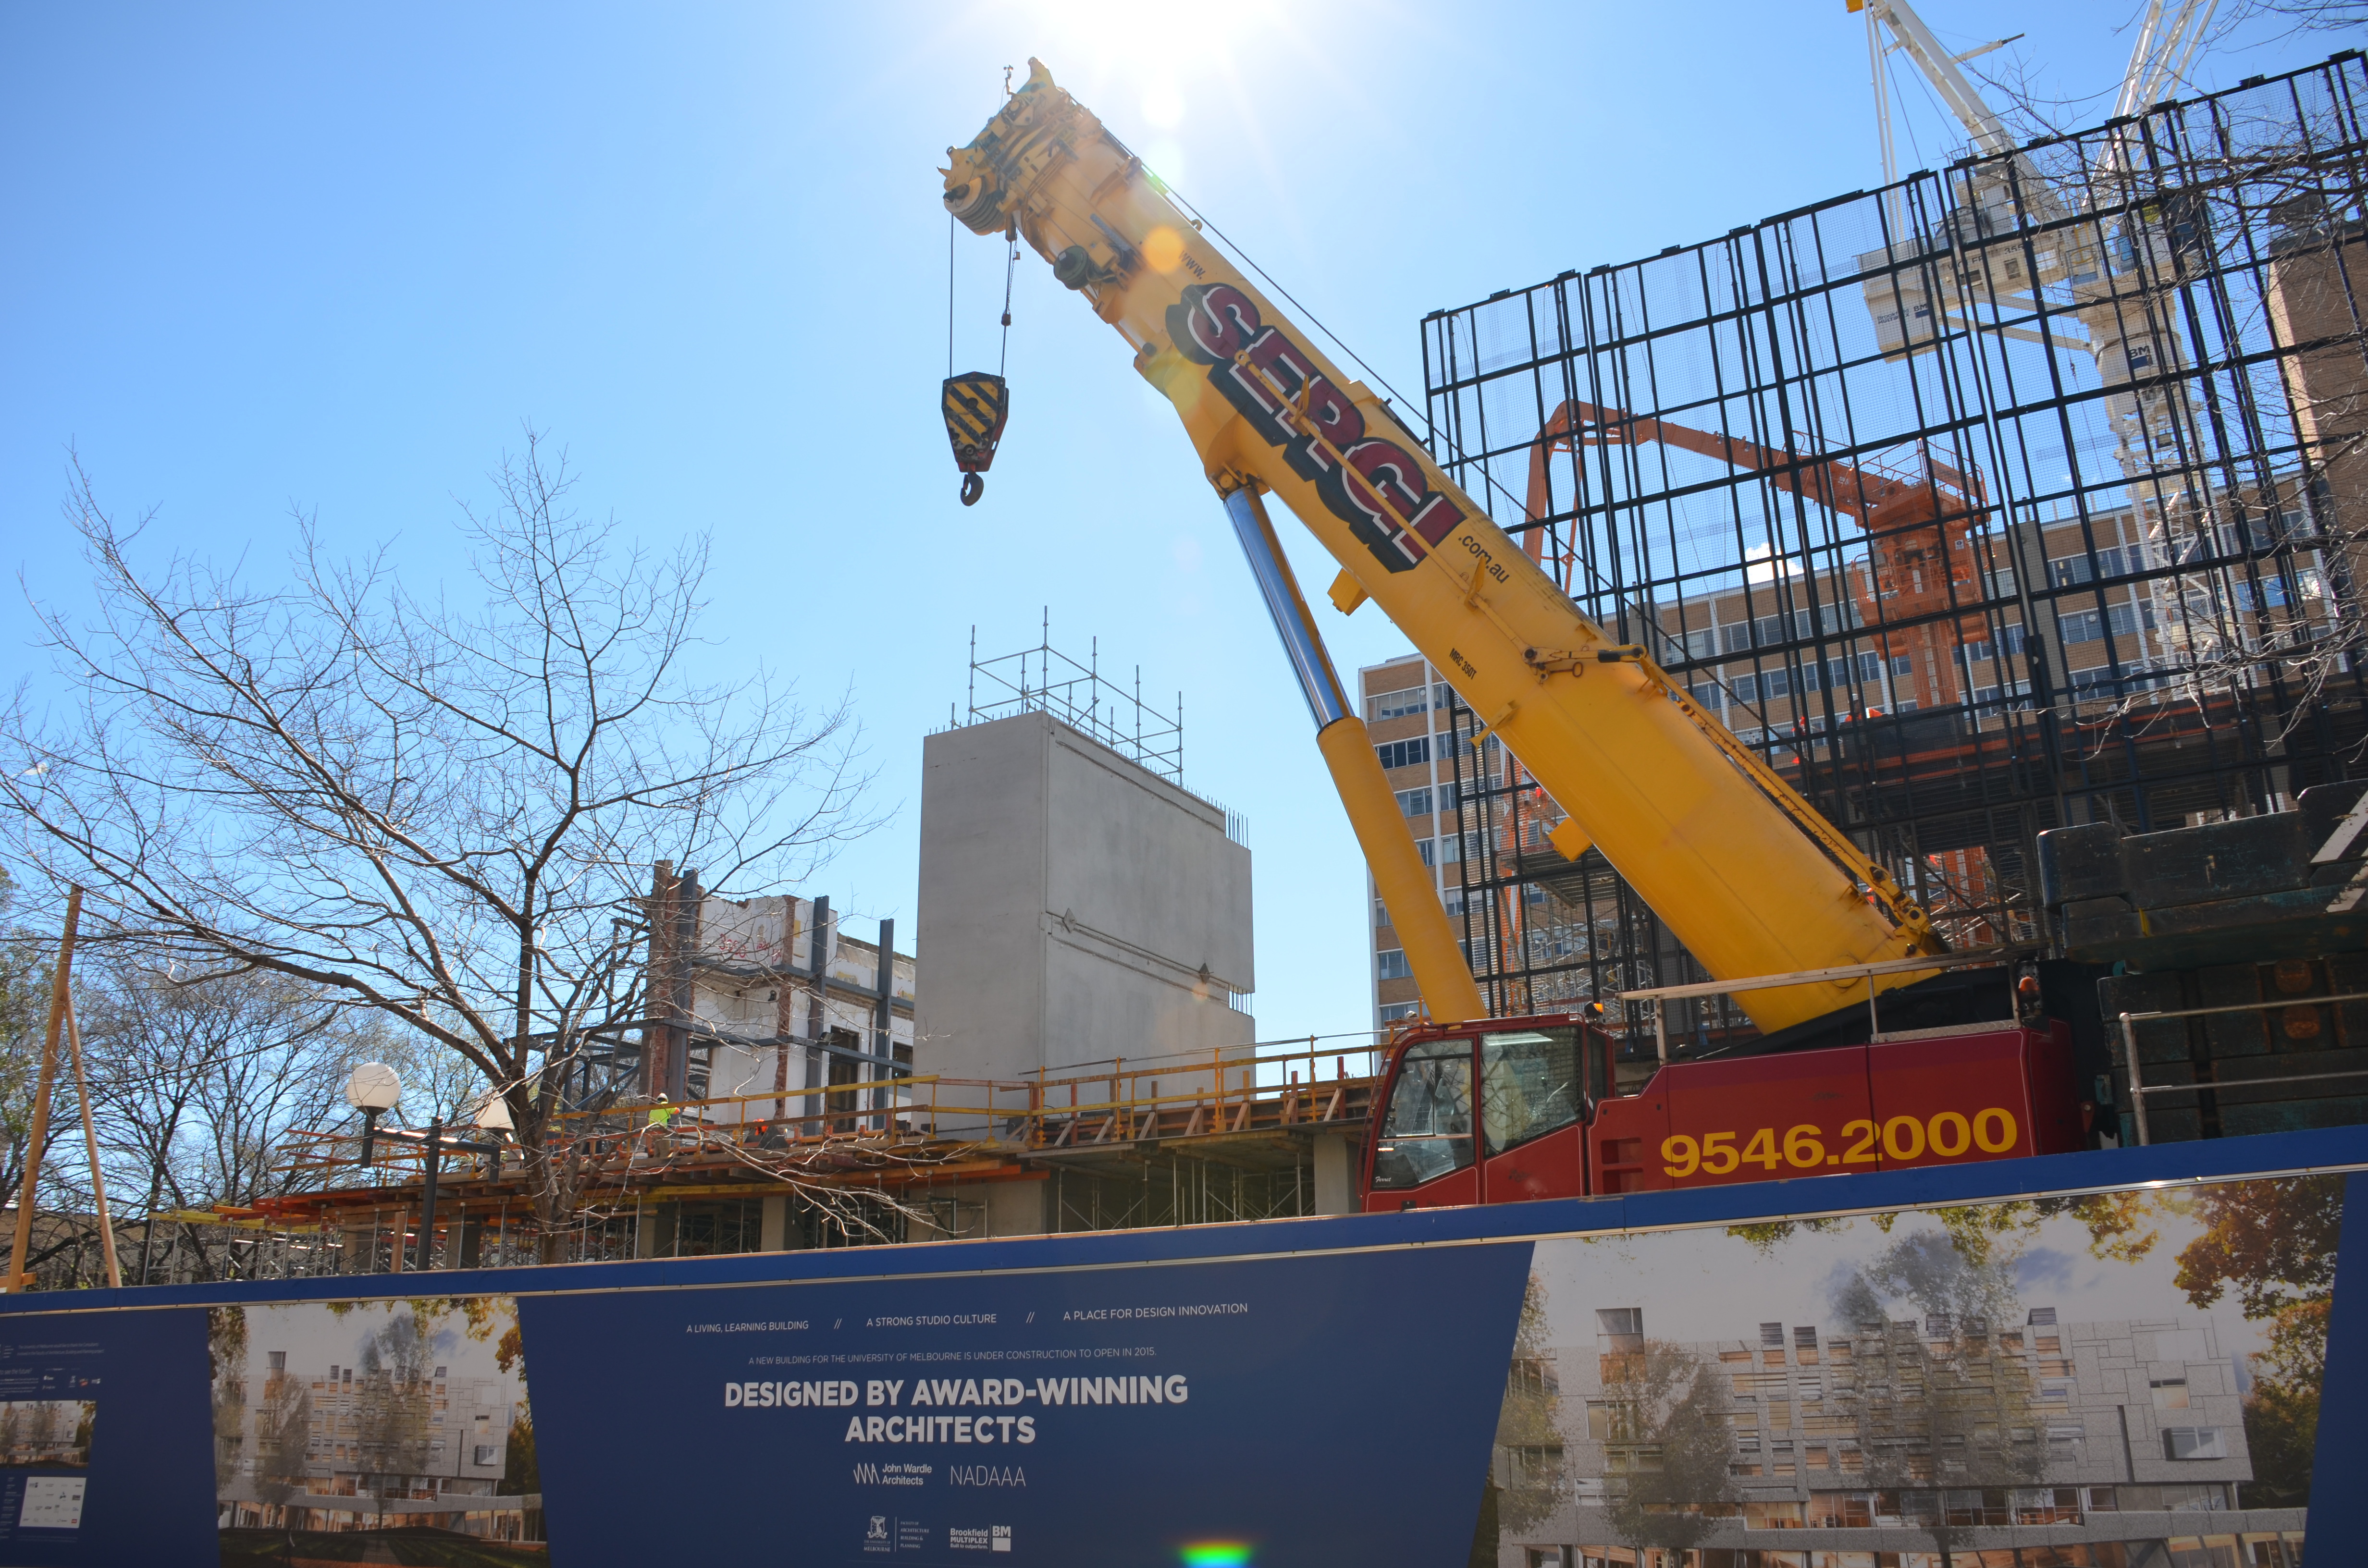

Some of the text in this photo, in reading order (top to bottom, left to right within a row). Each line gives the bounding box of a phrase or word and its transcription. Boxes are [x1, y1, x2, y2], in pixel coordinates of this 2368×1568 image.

[2129, 345, 2151, 358] BM
[1178, 249, 1510, 584] www. SERGI .com.au
[1449, 648, 1477, 680] MRC 350T
[1661, 1108, 2017, 1177] 9546.2000
[686, 1324, 692, 1333] A
[694, 1323, 723, 1333] LIVING,
[725, 1322, 767, 1332] LEARNING
[769, 1320, 809, 1331] BUILDING
[866, 1318, 873, 1327] A
[876, 1316, 913, 1327] STRONG
[916, 1315, 950, 1325] STUDIO
[953, 1313, 997, 1324] CULTURE
[1063, 1311, 1071, 1321] A
[1074, 1310, 1107, 1320] PLACE
[1110, 1309, 1132, 1319] FOR
[1135, 1306, 1175, 1318] DESIGN
[1179, 1302, 1247, 1316] INNOVATION
[776, 1355, 811, 1364] BUILDING
[813, 1355, 829, 1363] FOR
[831, 1354, 846, 1362] THE
[848, 1353, 894, 1362] UNIVERSITY
[896, 1353, 908, 1361] OF
[910, 1352, 962, 1361] MELBOURNE
[964, 1351, 972, 1360] IS
[974, 1351, 1004, 1360] UNDER
[1006, 1349, 1076, 1360] CONSTRUCTION
[1079, 1348, 1091, 1358] TO
[1094, 1348, 1120, 1358] OPEN
[1122, 1348, 1132, 1357] IN
[1135, 1347, 1157, 1356] 2015.
[725, 1374, 1188, 1407] DESIGNED BY AWARD-WINNING
[845, 1415, 1036, 1443] ARCHITECTS
[882, 1463, 932, 1473] John Wardle
[950, 1465, 1026, 1487] NADAAA
[882, 1475, 924, 1485] Architects
[950, 1528, 988, 1537] Brookfield
[992, 1525, 1011, 1537] BM
